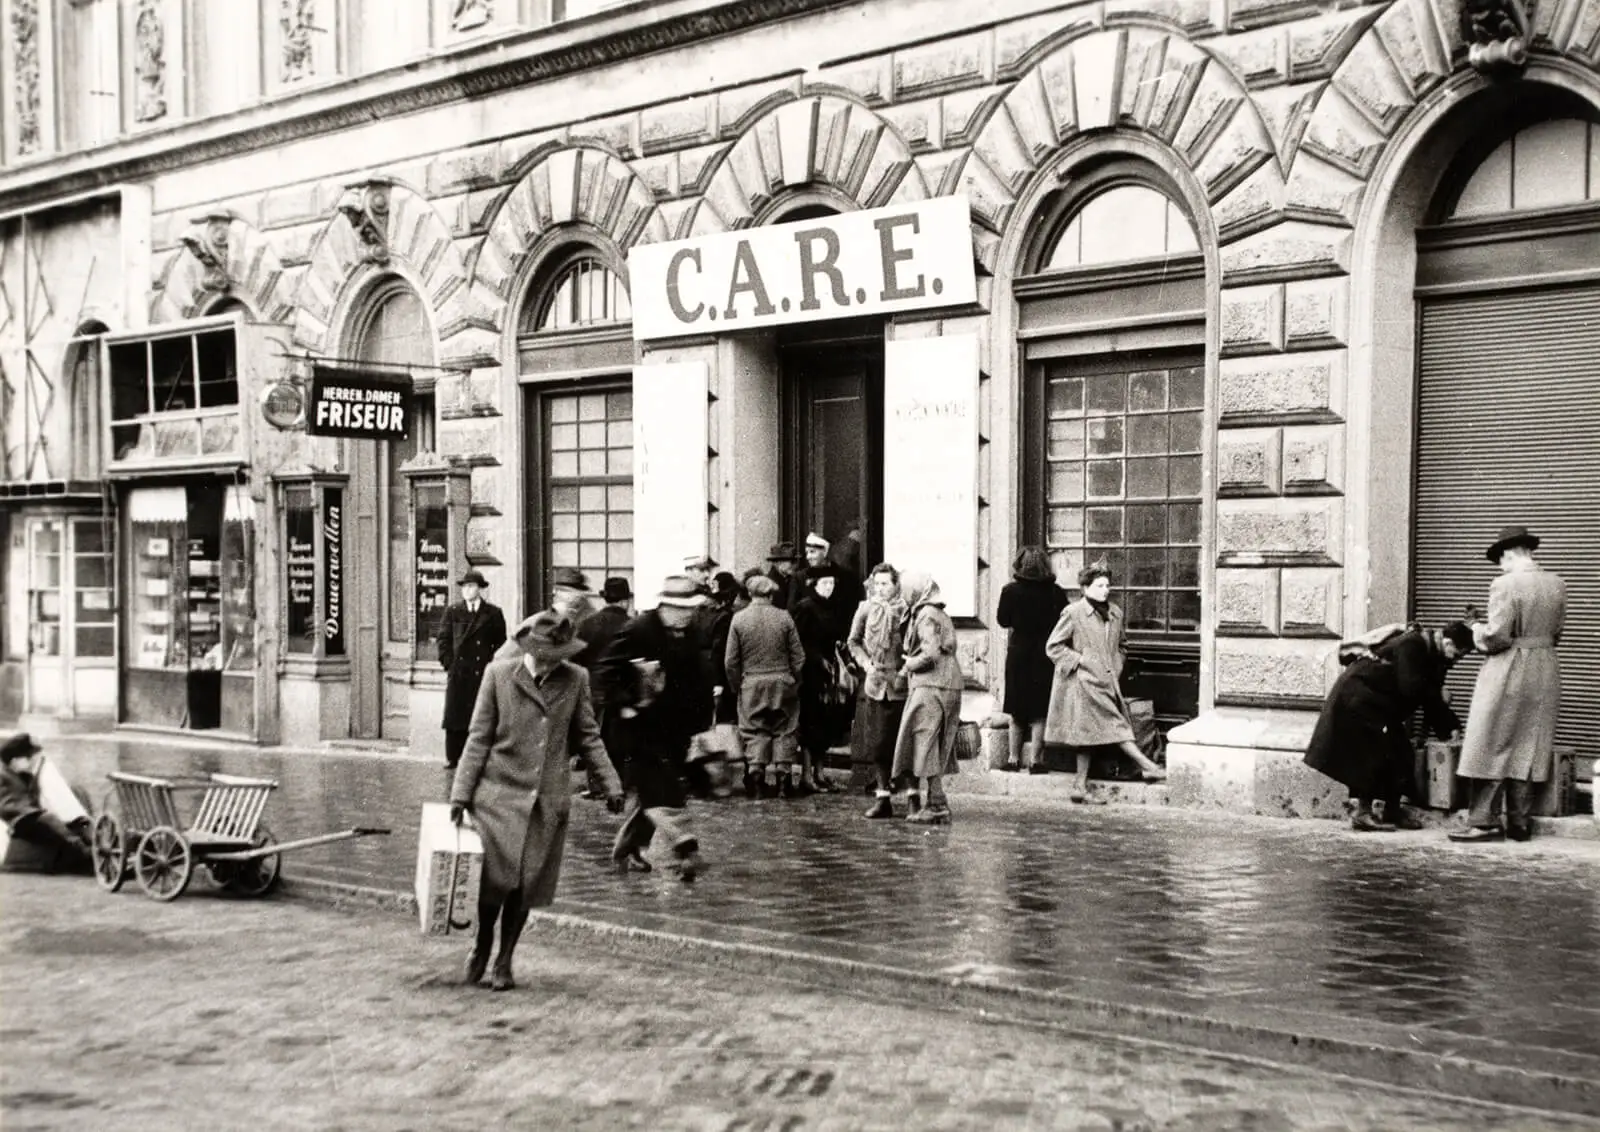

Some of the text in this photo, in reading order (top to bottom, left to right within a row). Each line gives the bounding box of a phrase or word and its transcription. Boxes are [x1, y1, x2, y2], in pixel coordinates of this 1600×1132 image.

[666, 213, 943, 323] C.A.R.E.
[317, 401, 404, 431] FRISEUR
[326, 506, 340, 639] Dauerwellen
